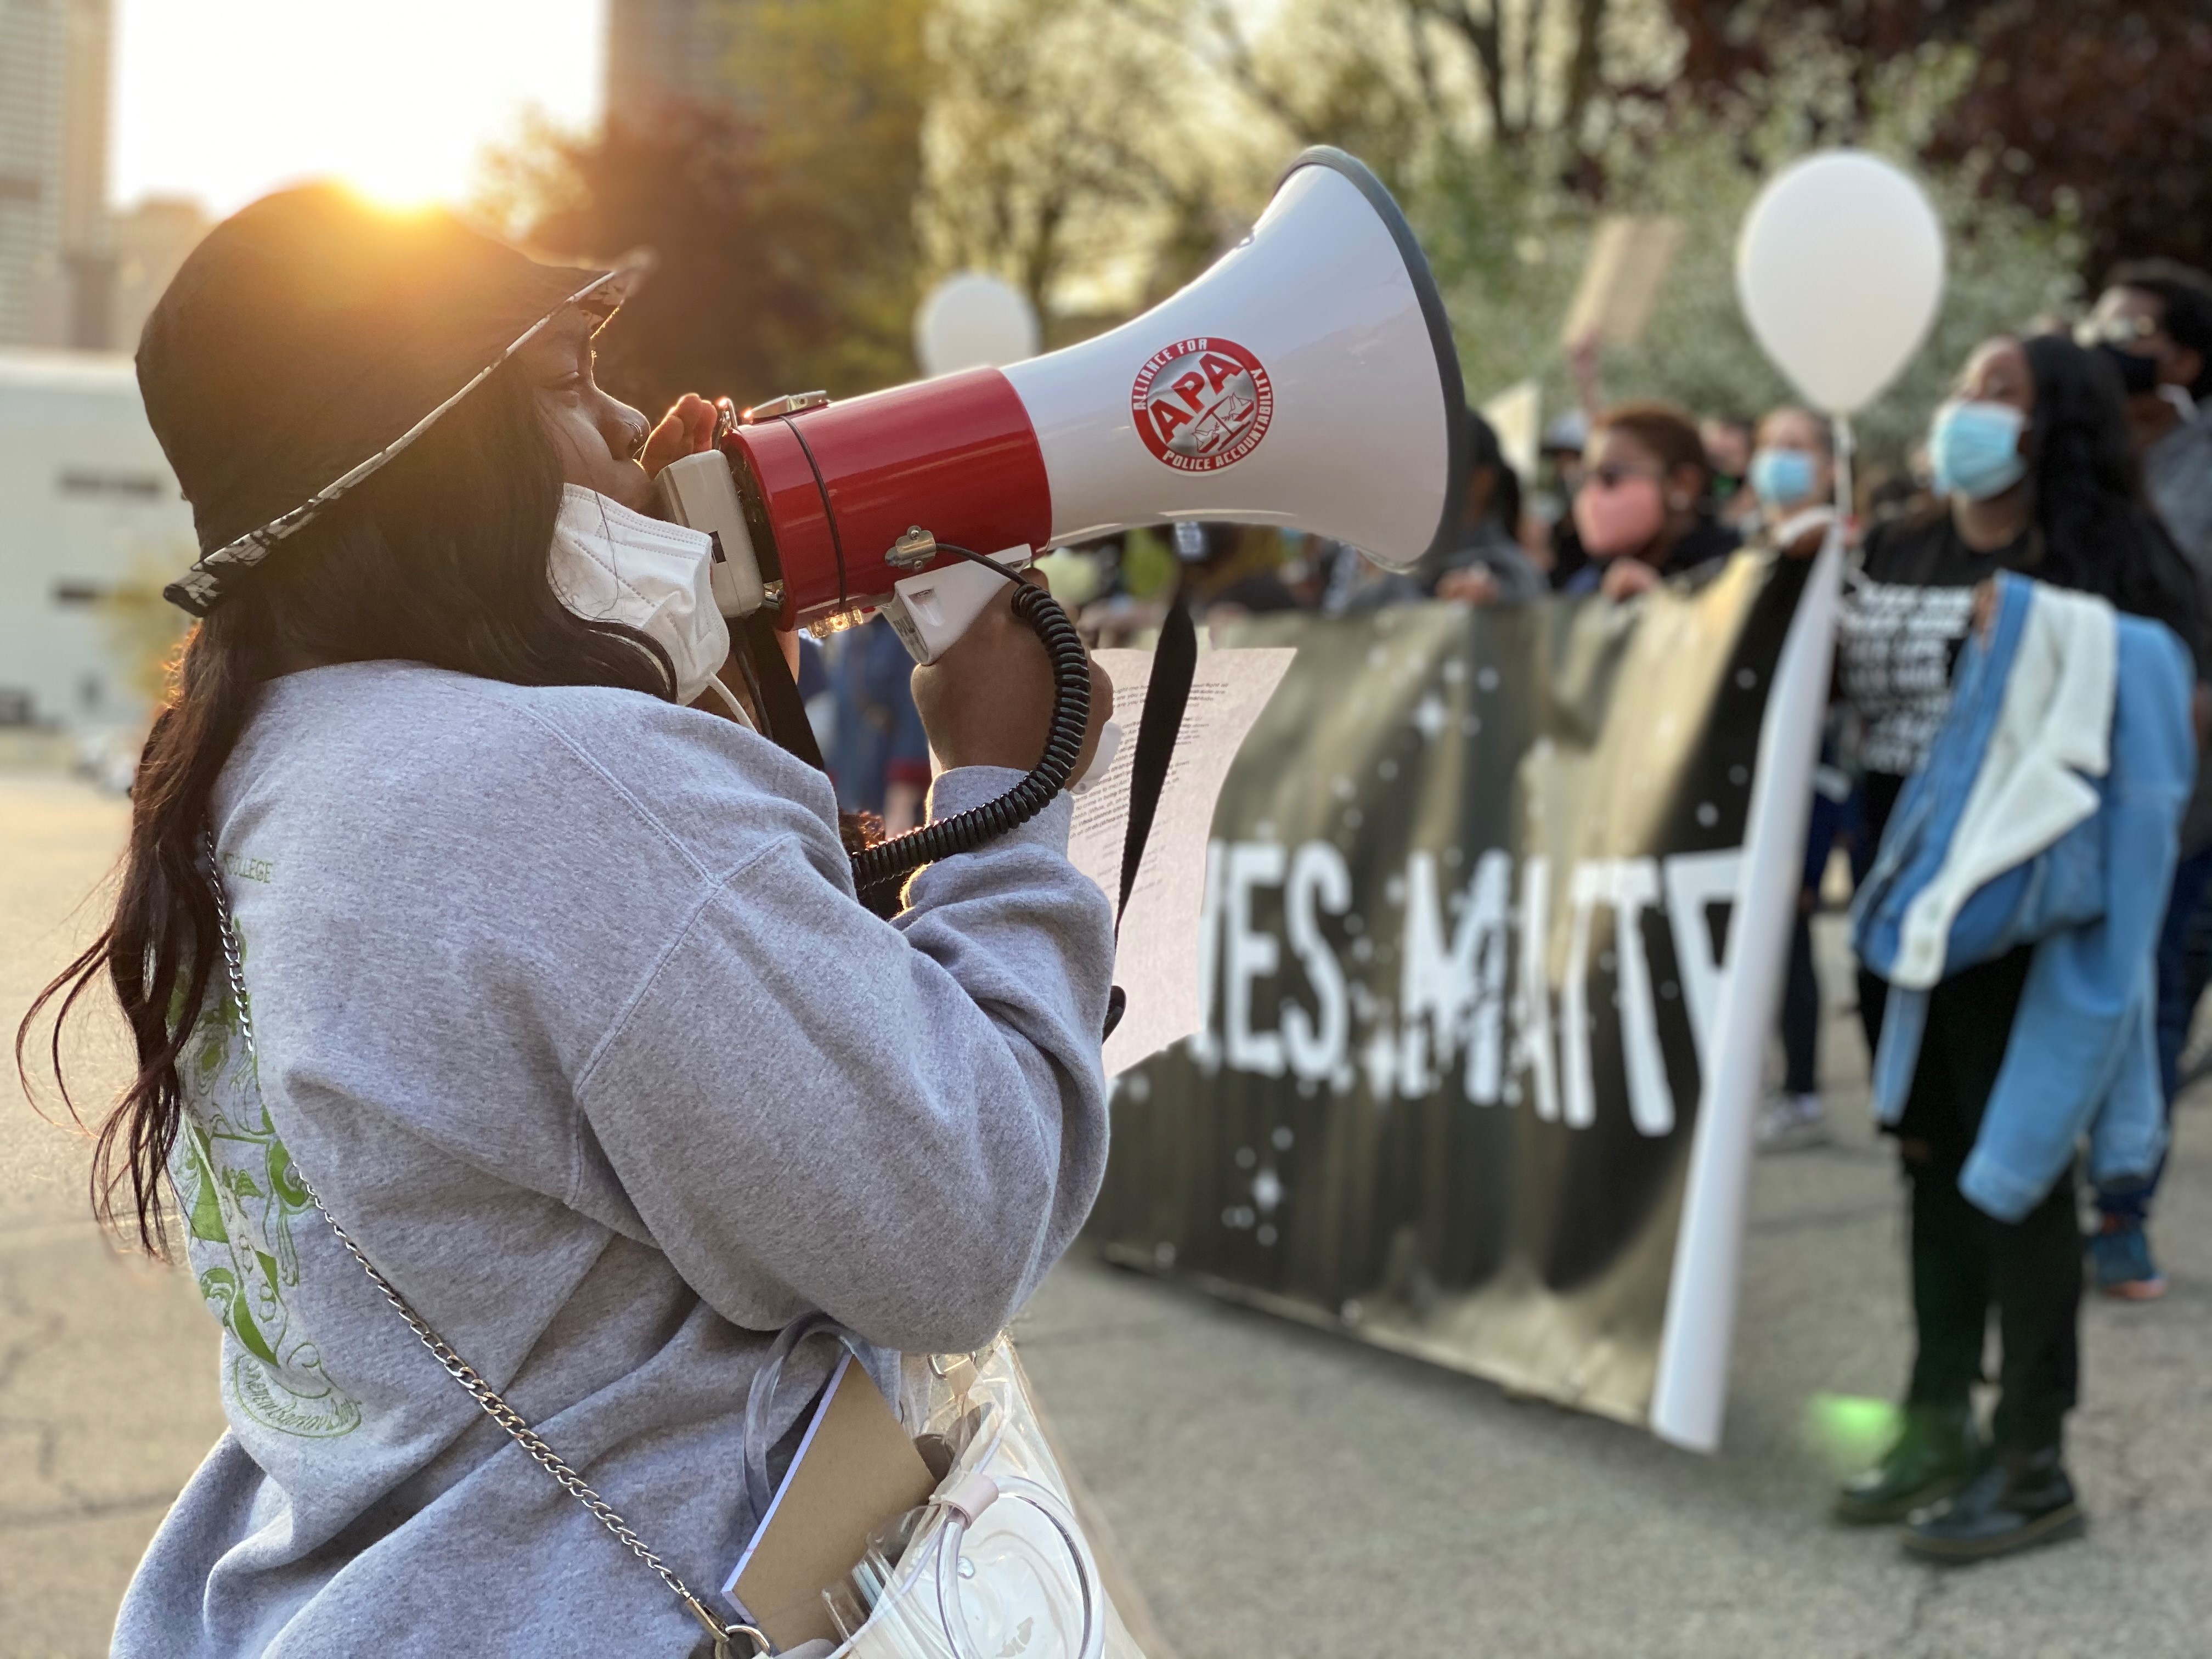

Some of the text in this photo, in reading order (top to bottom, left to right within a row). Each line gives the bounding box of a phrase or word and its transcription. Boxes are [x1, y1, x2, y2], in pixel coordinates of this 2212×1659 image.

[1133, 338, 1207, 410] ALLIANCE FOR
[1150, 353, 1244, 444] APA
[1163, 368, 1272, 470] POLICE ACCOUNTABILITY
[1196, 839, 1353, 1080] ES
